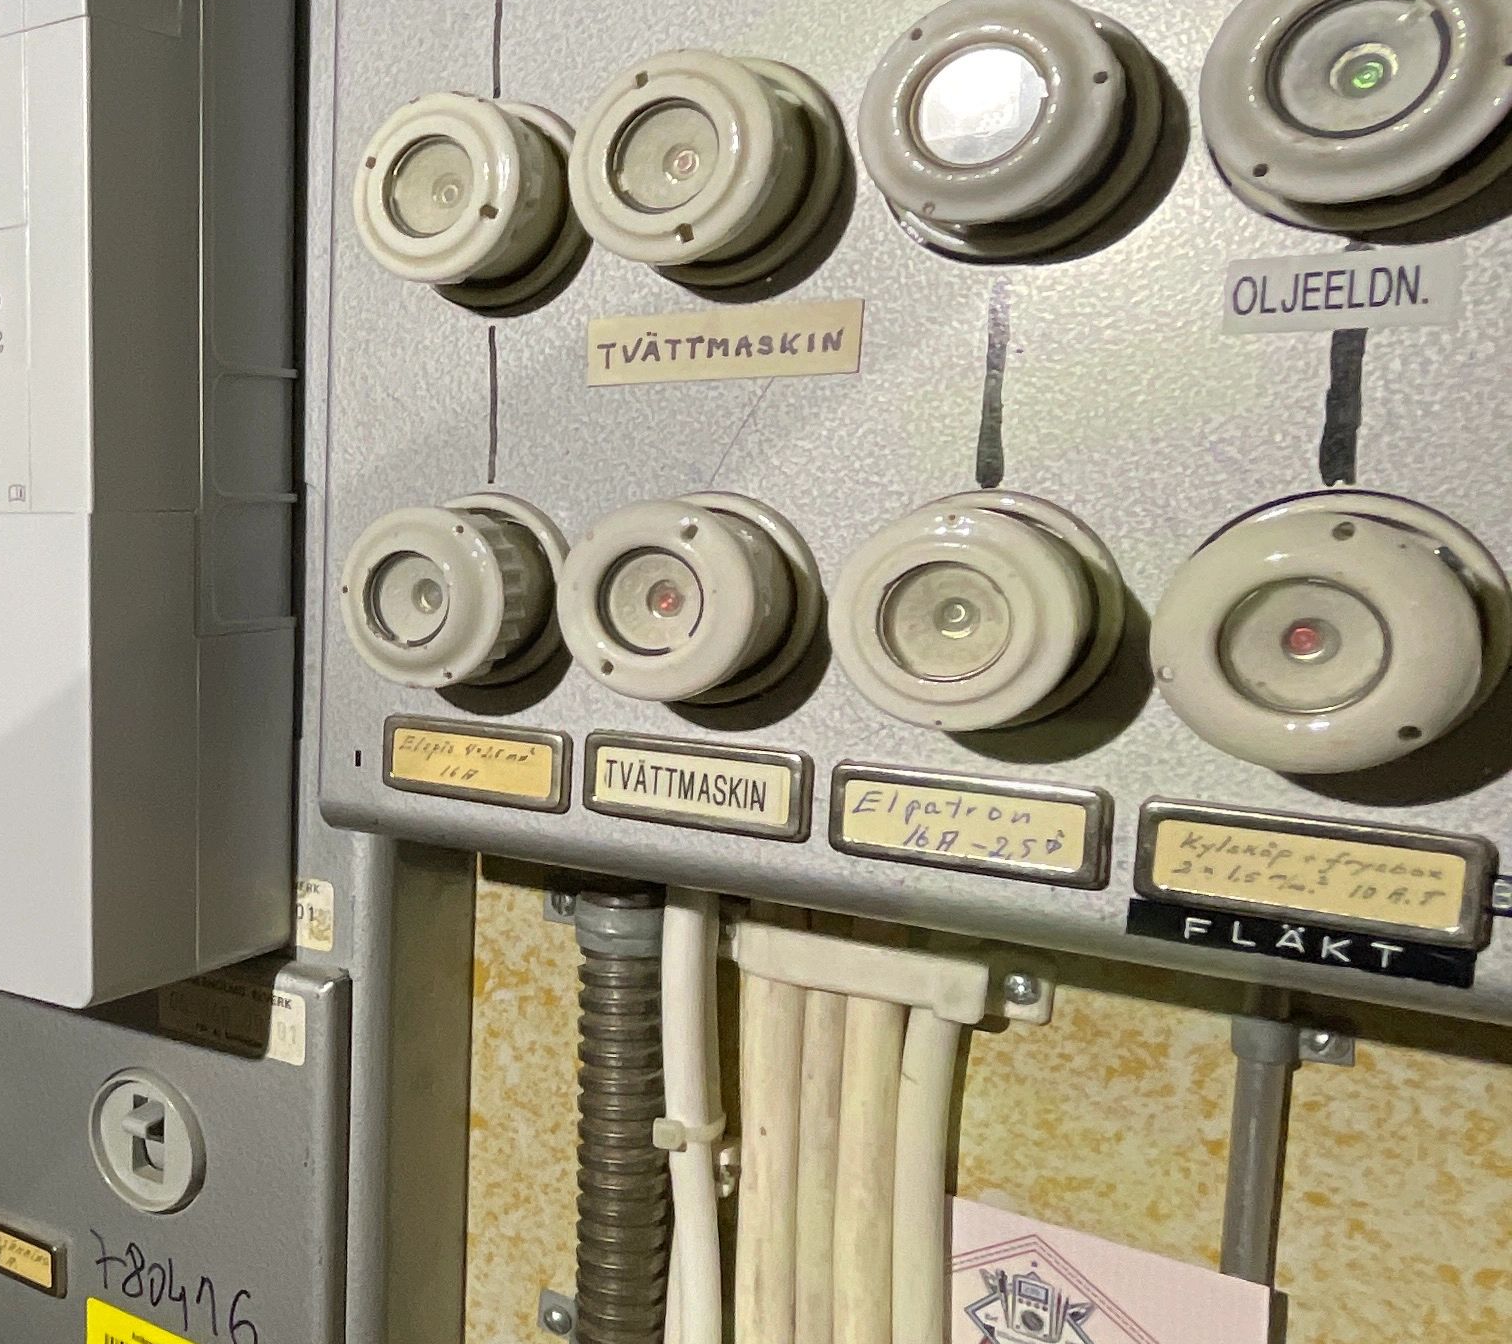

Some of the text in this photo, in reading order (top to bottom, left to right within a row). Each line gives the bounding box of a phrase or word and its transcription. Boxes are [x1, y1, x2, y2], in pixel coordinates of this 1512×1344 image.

[1230, 266, 1430, 316] OLJEELDN.
[596, 327, 846, 371] TVÄTTMASKIN
[604, 756, 768, 814] TVÄTTMASKIN
[1183, 916, 1405, 969] FLÄKT
